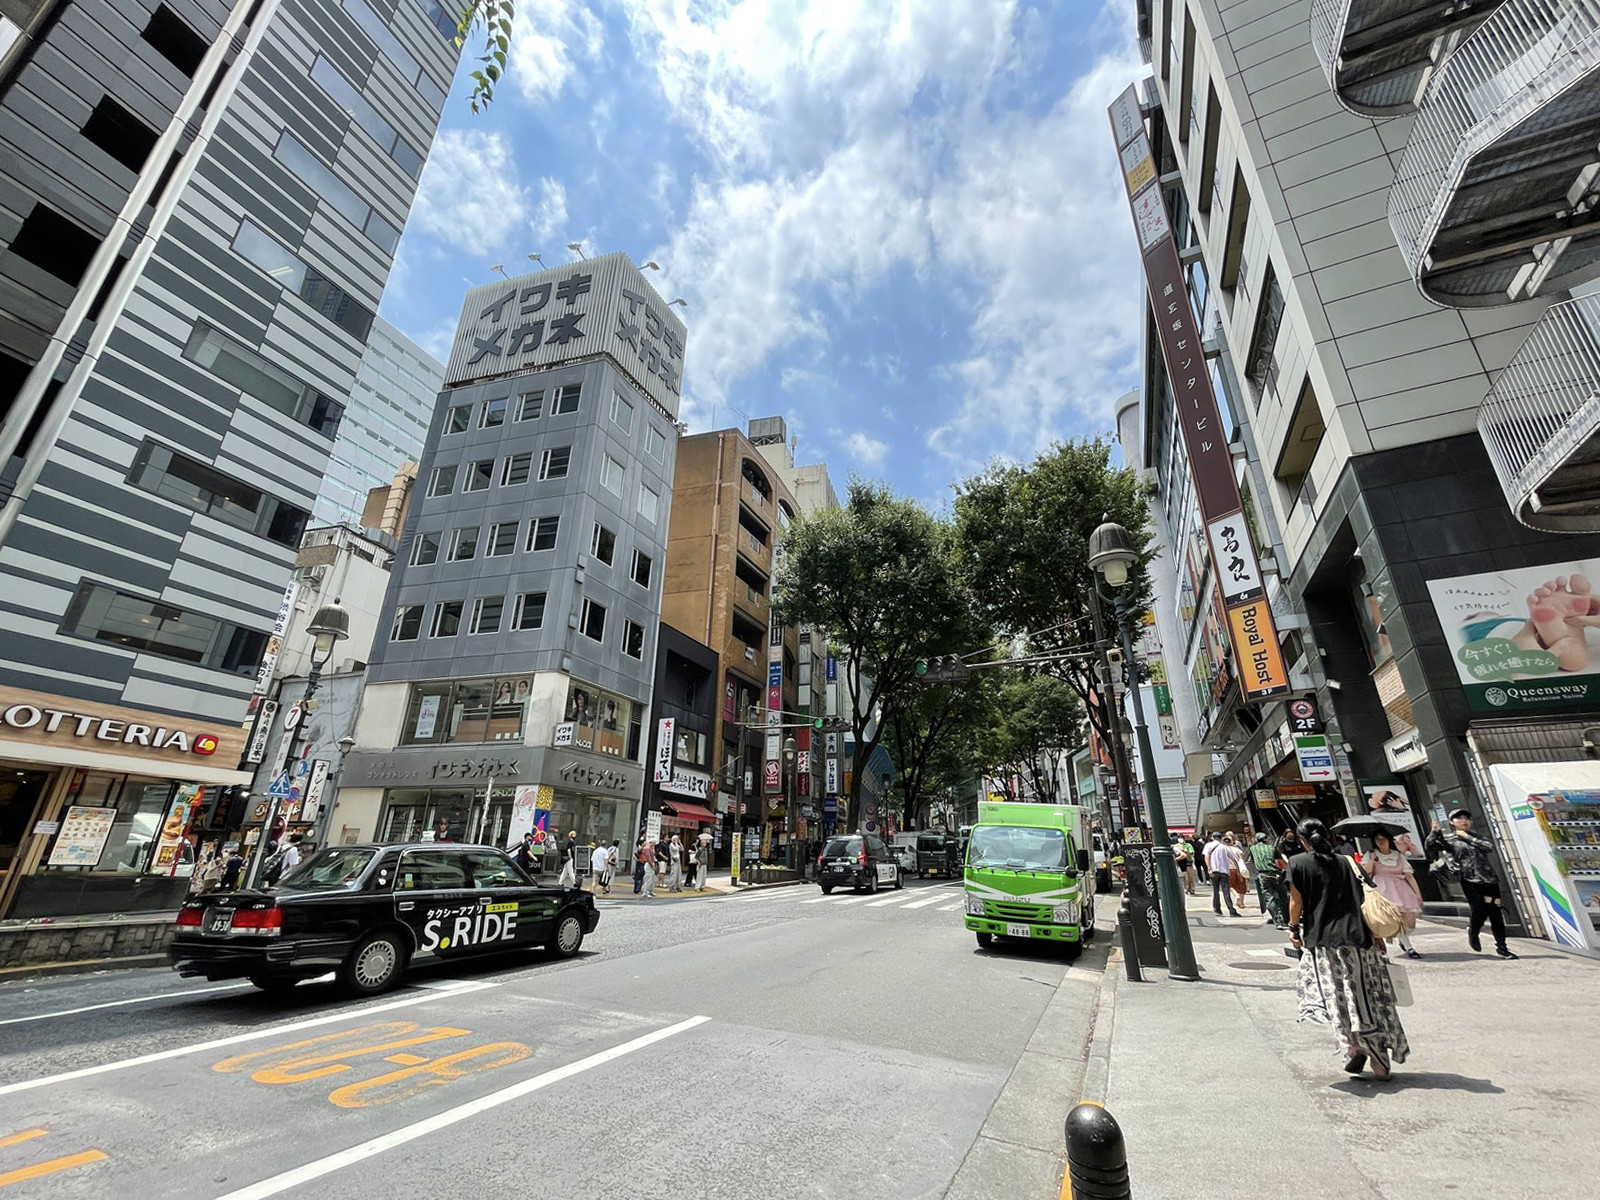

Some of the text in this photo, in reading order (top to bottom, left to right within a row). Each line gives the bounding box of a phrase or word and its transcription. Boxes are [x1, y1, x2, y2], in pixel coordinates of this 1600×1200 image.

[480, 273, 592, 322] イワキ
[467, 312, 586, 364] メガネ
[622, 288, 683, 360] イワキ
[615, 312, 680, 396] メガネ
[1163, 283, 1212, 452] 道玄坂センタービル
[1241, 606, 1273, 685] Royal Host
[1473, 656, 1555, 676] 疲れを癒すなら
[1507, 685, 1588, 699] Queensway
[0, 704, 189, 752] OTTERIA
[288, 709, 298, 725] 7
[1296, 718, 1315, 729] 2F
[556, 734, 571, 742] メガネ
[660, 747, 671, 780] ほてい
[421, 912, 519, 952] S.RIDE
[427, 905, 483, 919] タクシーアプリ
